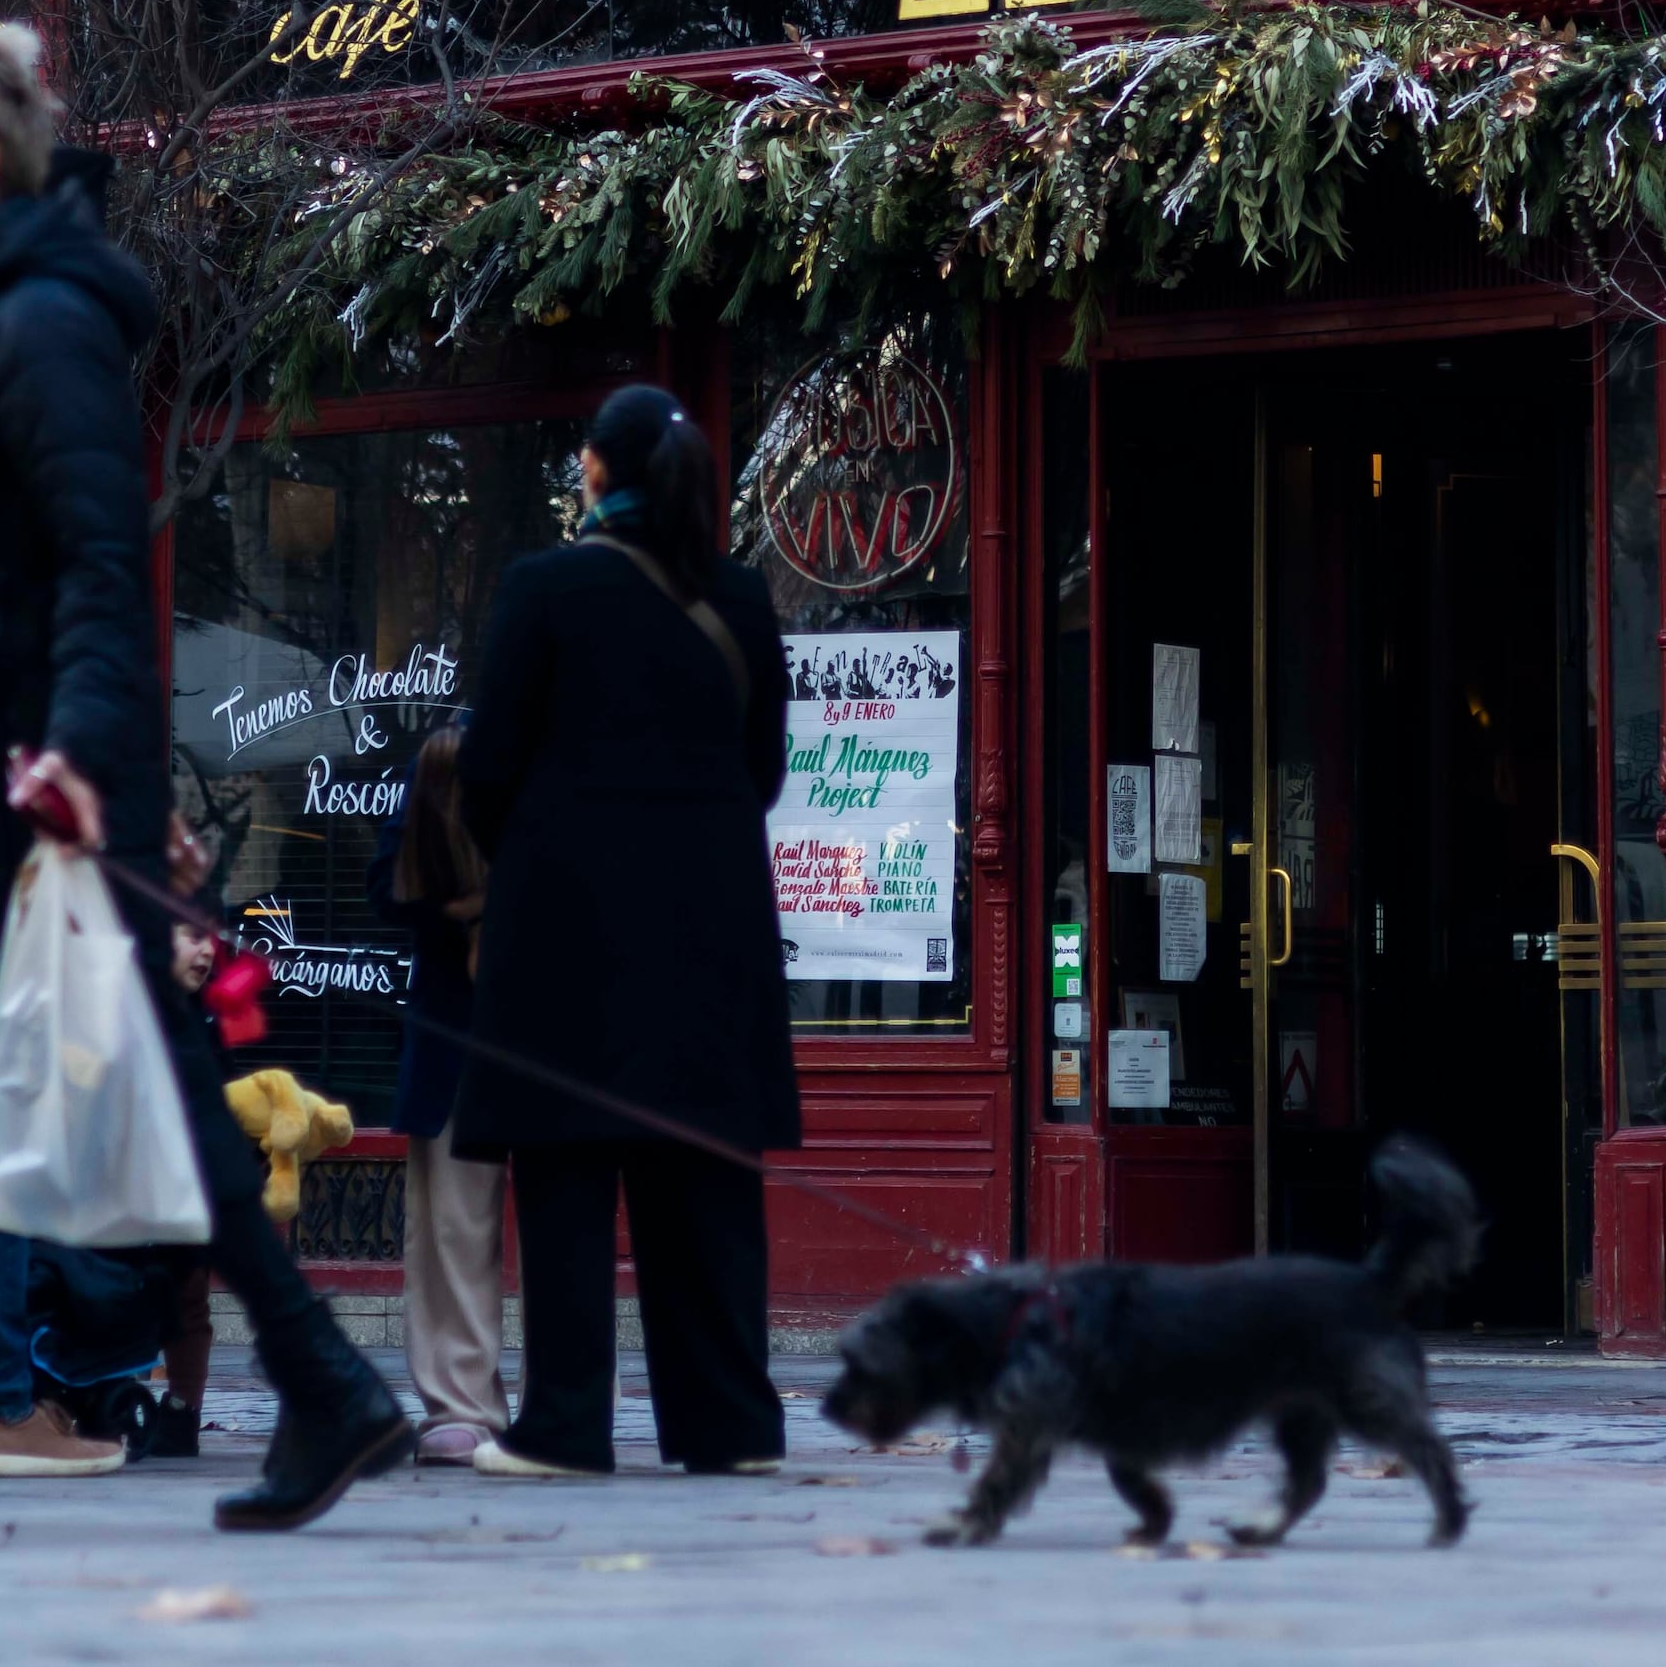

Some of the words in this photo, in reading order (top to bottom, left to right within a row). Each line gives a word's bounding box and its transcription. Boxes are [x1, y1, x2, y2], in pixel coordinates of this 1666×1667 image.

[776, 484, 935, 570] VIVO
[211, 684, 313, 752] Tenemos
[329, 643, 459, 707] Chocolate
[854, 701, 896, 721] ENERO
[355, 714, 389, 756] &
[828, 733, 933, 789] Márquez
[807, 776, 888, 817] Project
[773, 839, 805, 861] Raúl
[879, 839, 928, 861] VIOLÍN
[772, 860, 813, 878] David
[878, 861, 922, 878] PIANO
[773, 878, 827, 897] Gonzalo
[828, 876, 879, 897] Maestre
[883, 876, 938, 896] BATERÍA
[801, 895, 865, 917] Sánchez
[870, 897, 935, 913] TROMPETA
